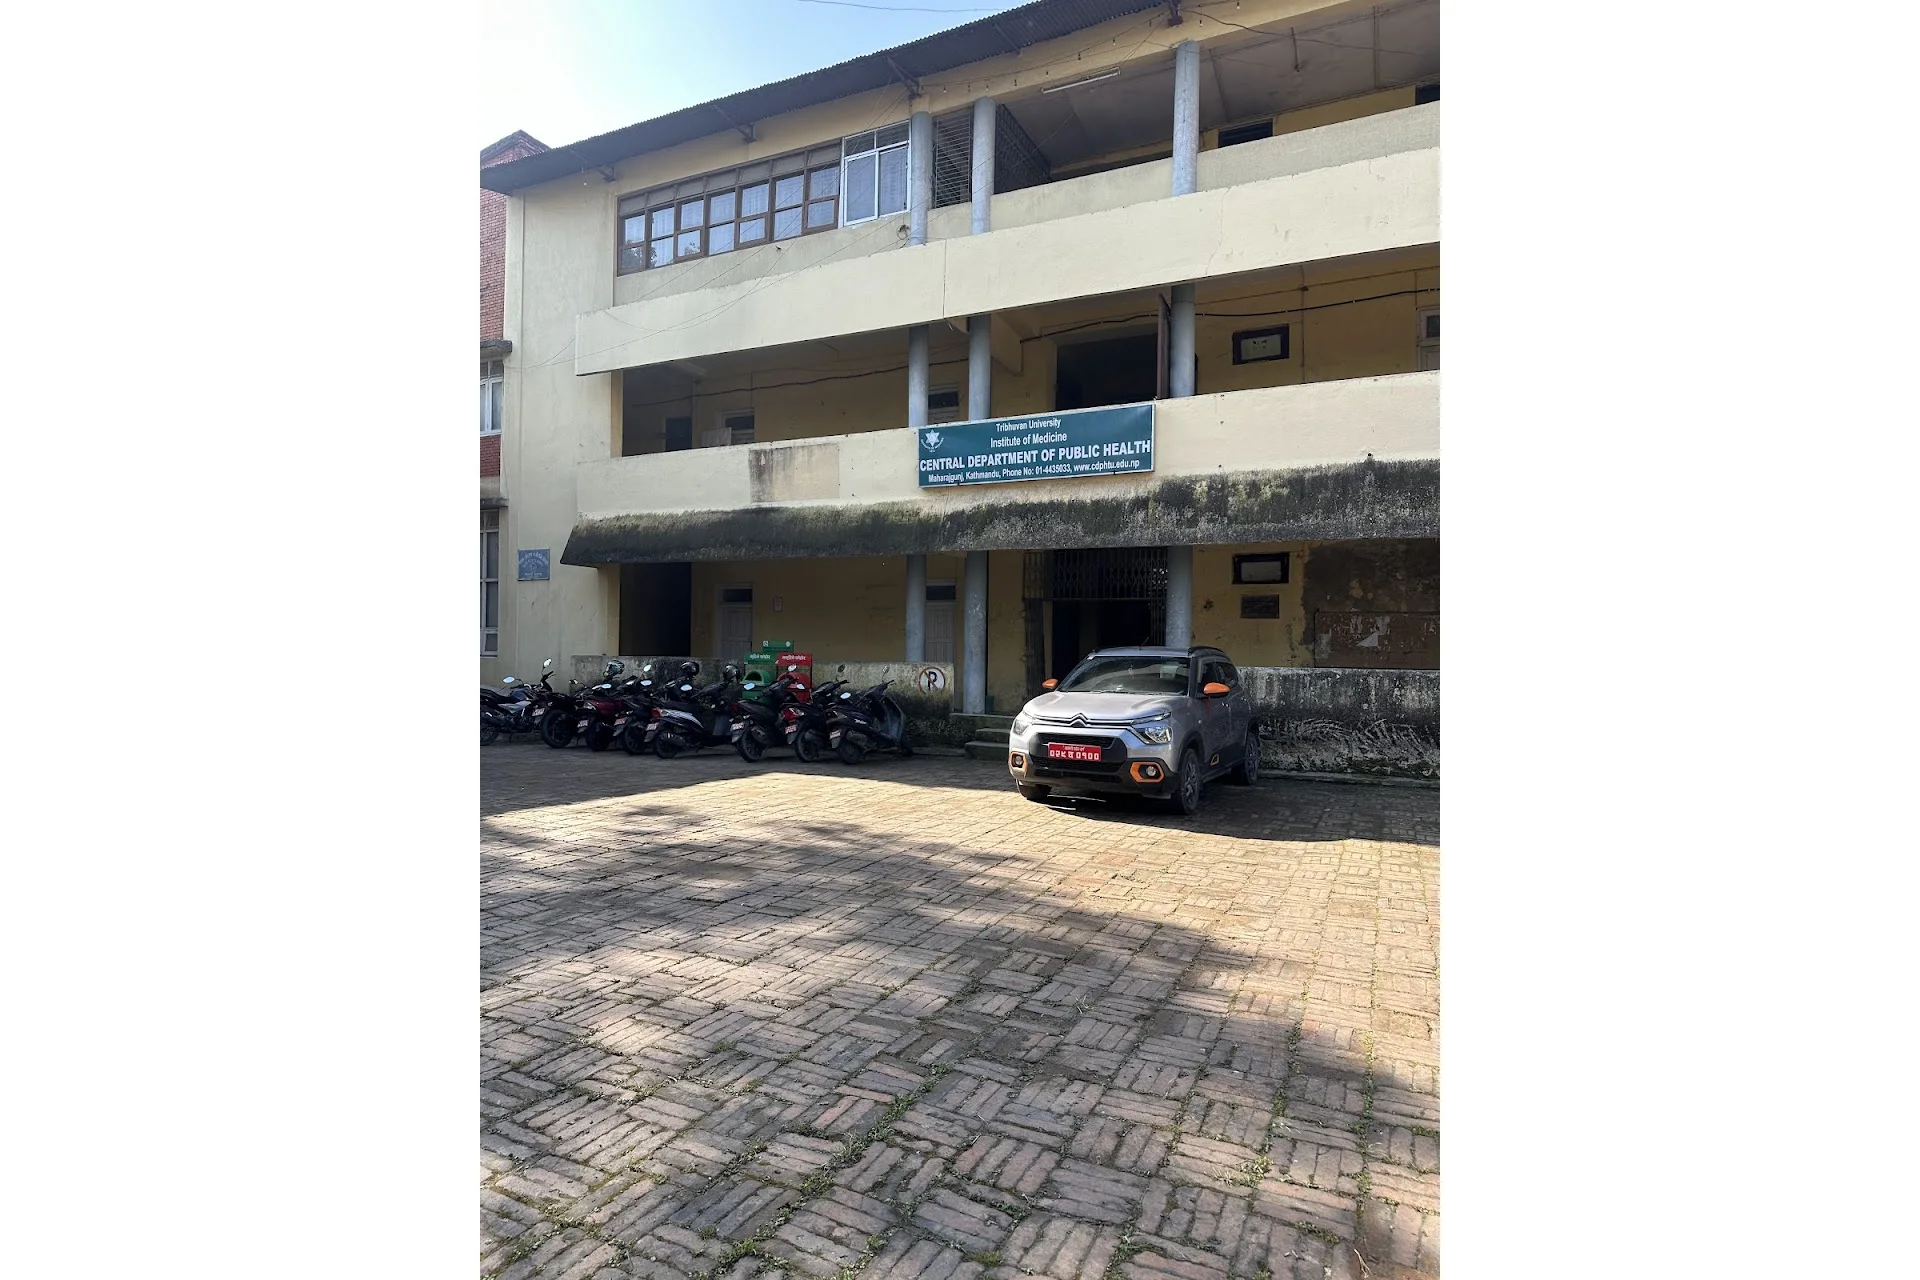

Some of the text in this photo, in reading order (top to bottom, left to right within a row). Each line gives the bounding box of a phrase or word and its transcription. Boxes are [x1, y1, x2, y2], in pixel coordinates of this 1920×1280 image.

[996, 418, 1062, 432] Tribhuvan University
[990, 432, 1068, 448] Institute of Medicine
[920, 440, 1151, 471] CENTRAL DEPARTMENT OF PUBLIC HEALTH
[928, 459, 1140, 483] Maharajgunj, Kathmandu, Phone No: 01-4435033, www.cdphtu.edu.np
